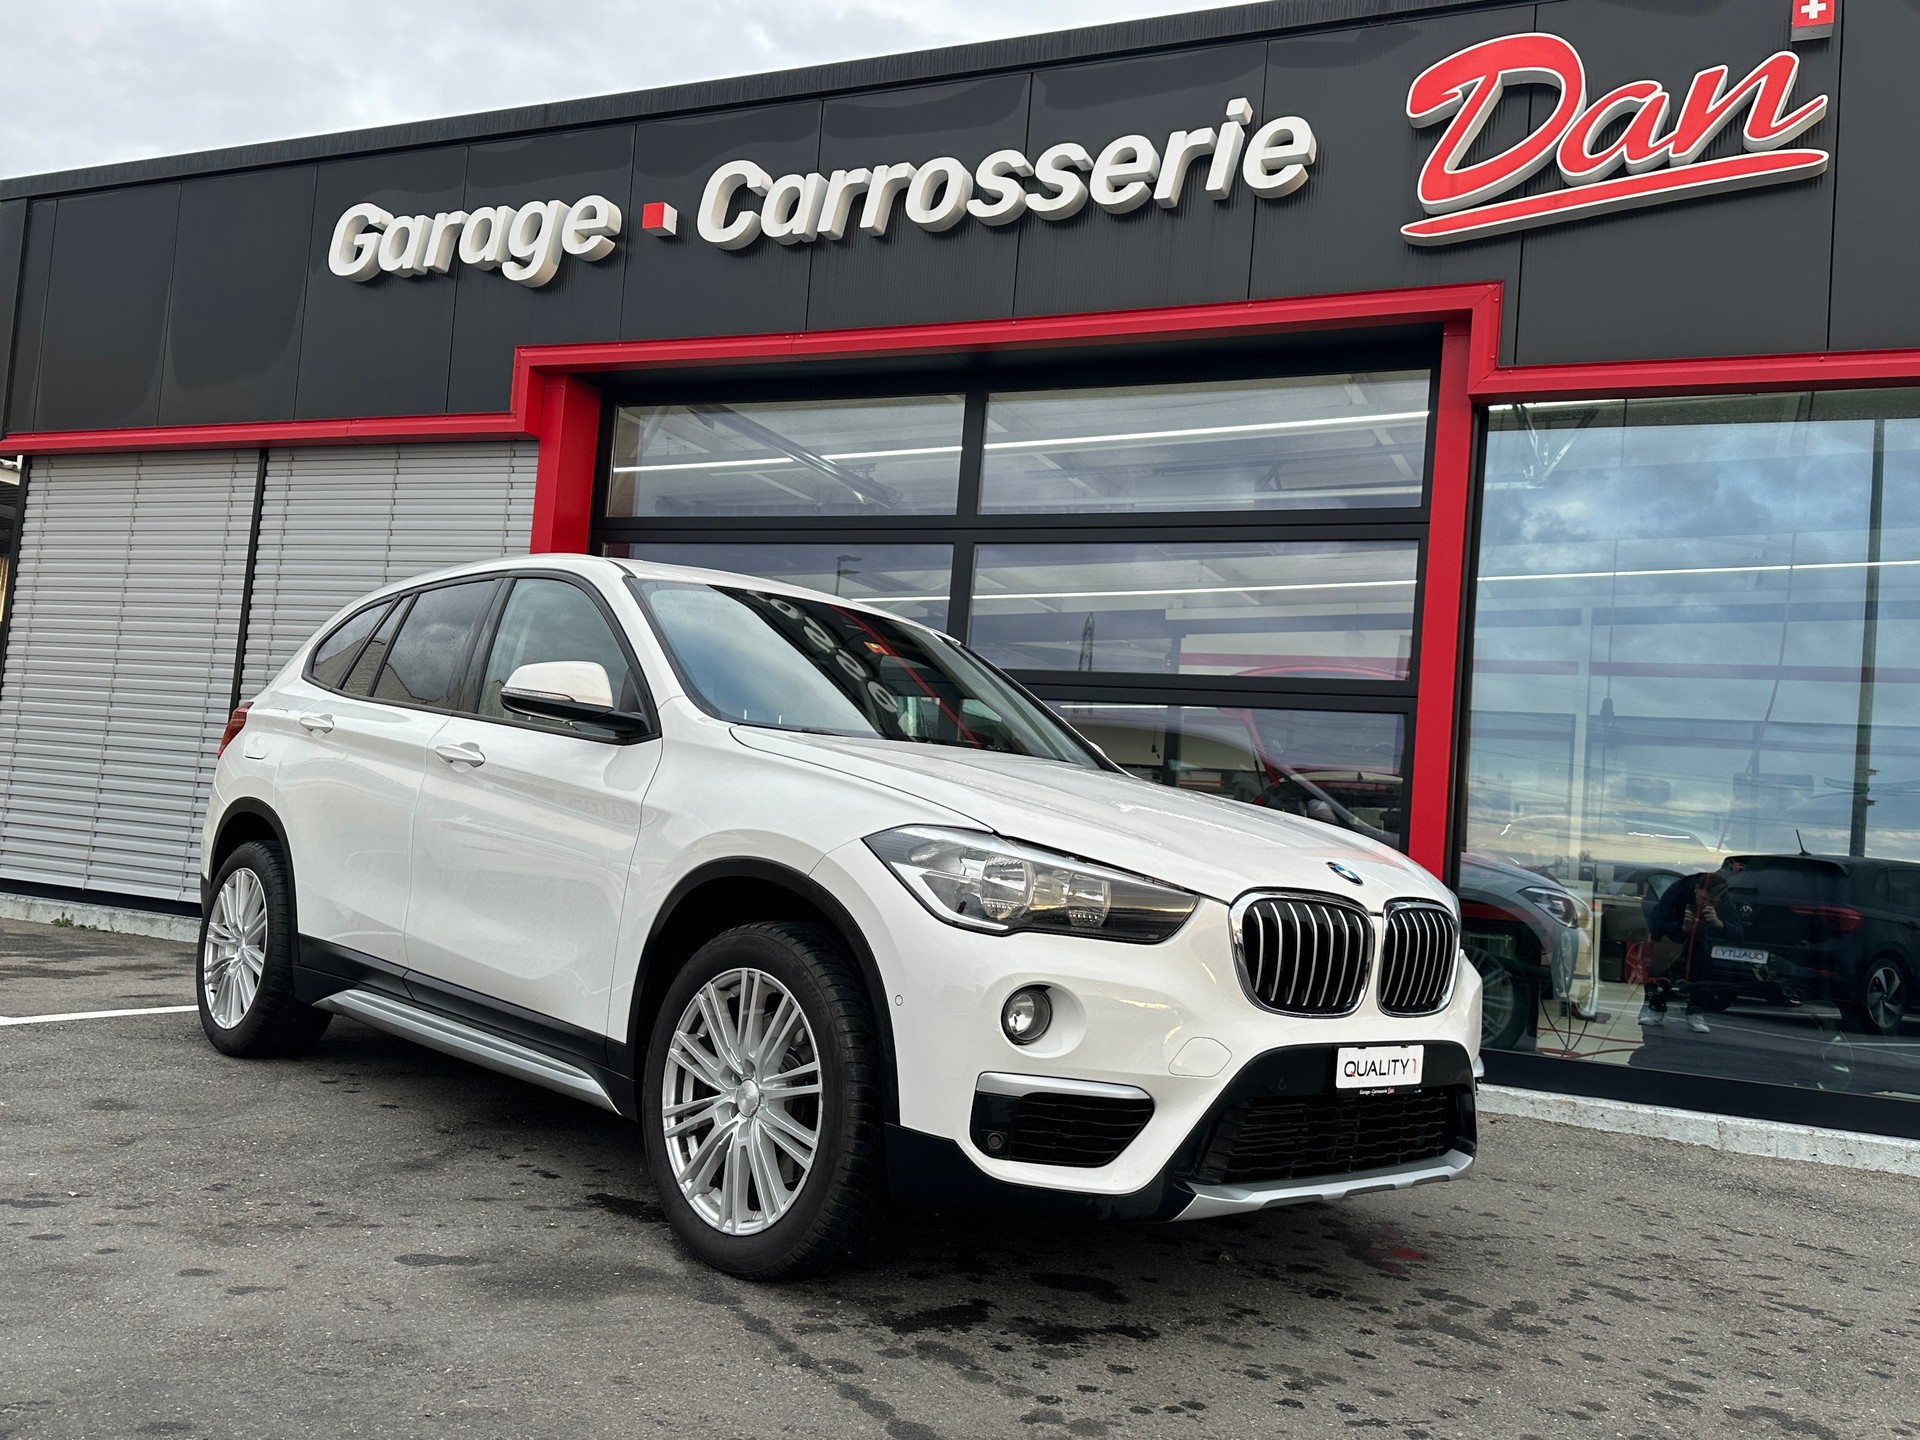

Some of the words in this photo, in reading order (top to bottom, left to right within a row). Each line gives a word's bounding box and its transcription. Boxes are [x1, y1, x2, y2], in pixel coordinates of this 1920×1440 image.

[328, 194, 622, 288] Garage
[697, 97, 1318, 250] Carrosserie
[1405, 31, 1829, 215] Dan
[1343, 1058, 1410, 1077] QUALITY
[1412, 1057, 1417, 1074] 1
